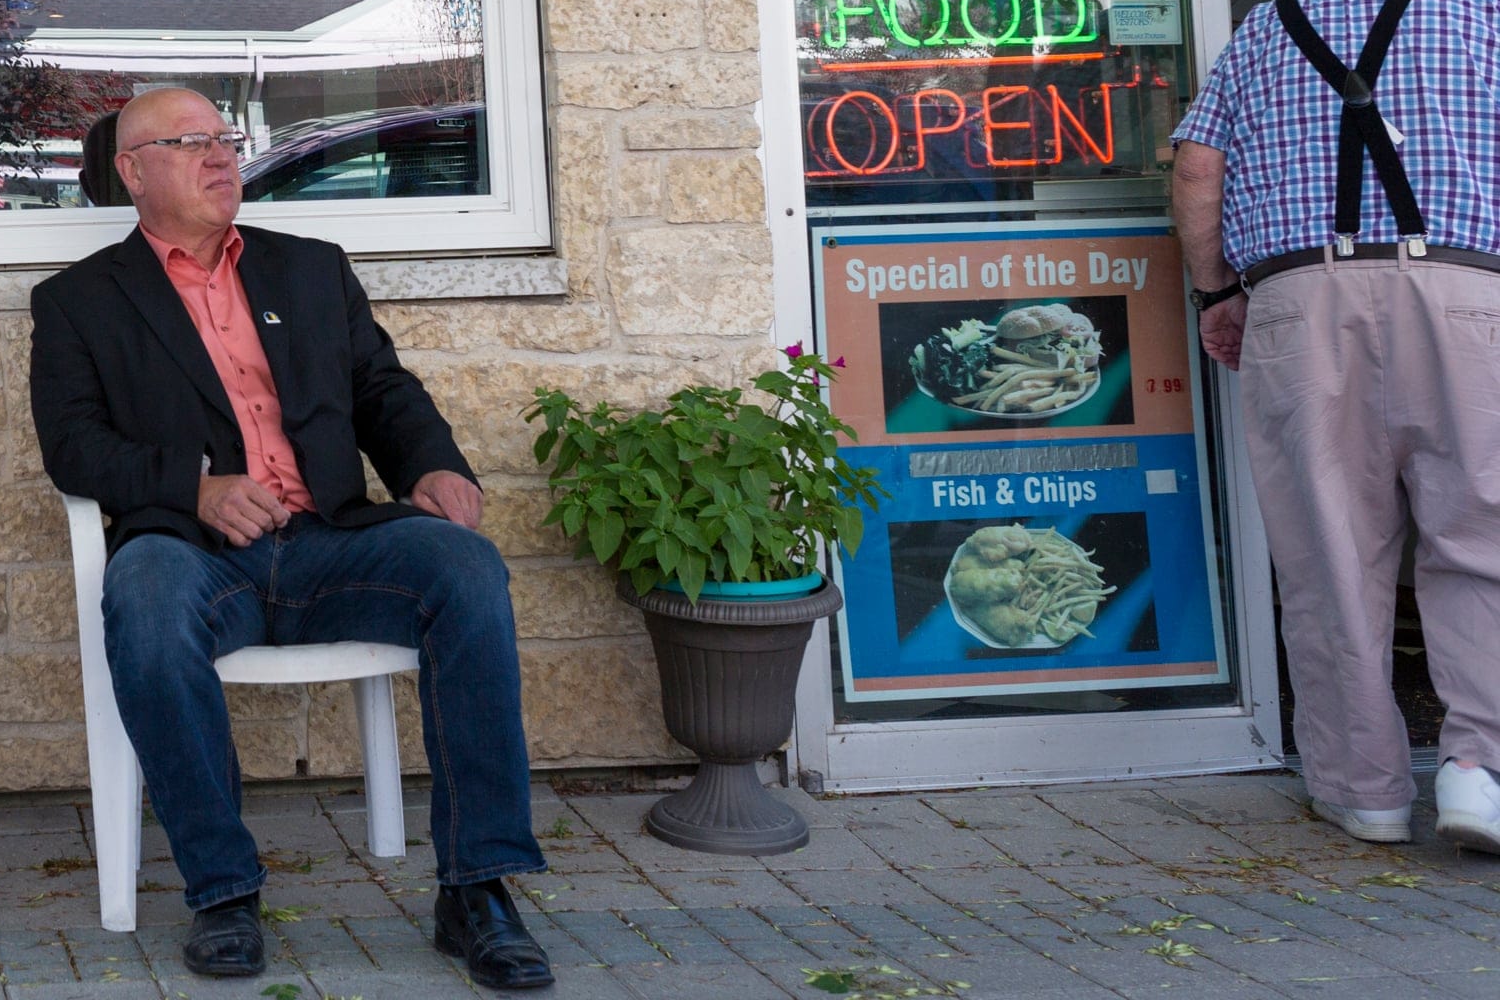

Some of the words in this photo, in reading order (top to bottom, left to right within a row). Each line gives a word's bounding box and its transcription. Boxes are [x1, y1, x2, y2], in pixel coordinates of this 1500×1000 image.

[825, 84, 1115, 175] OPEN
[845, 256, 968, 299] Special
[980, 255, 1012, 289] of
[1023, 253, 1077, 286] the
[1088, 252, 1149, 291] Day
[932, 479, 985, 507] Fish
[995, 478, 1015, 505] &
[1024, 475, 1097, 508] Chips
